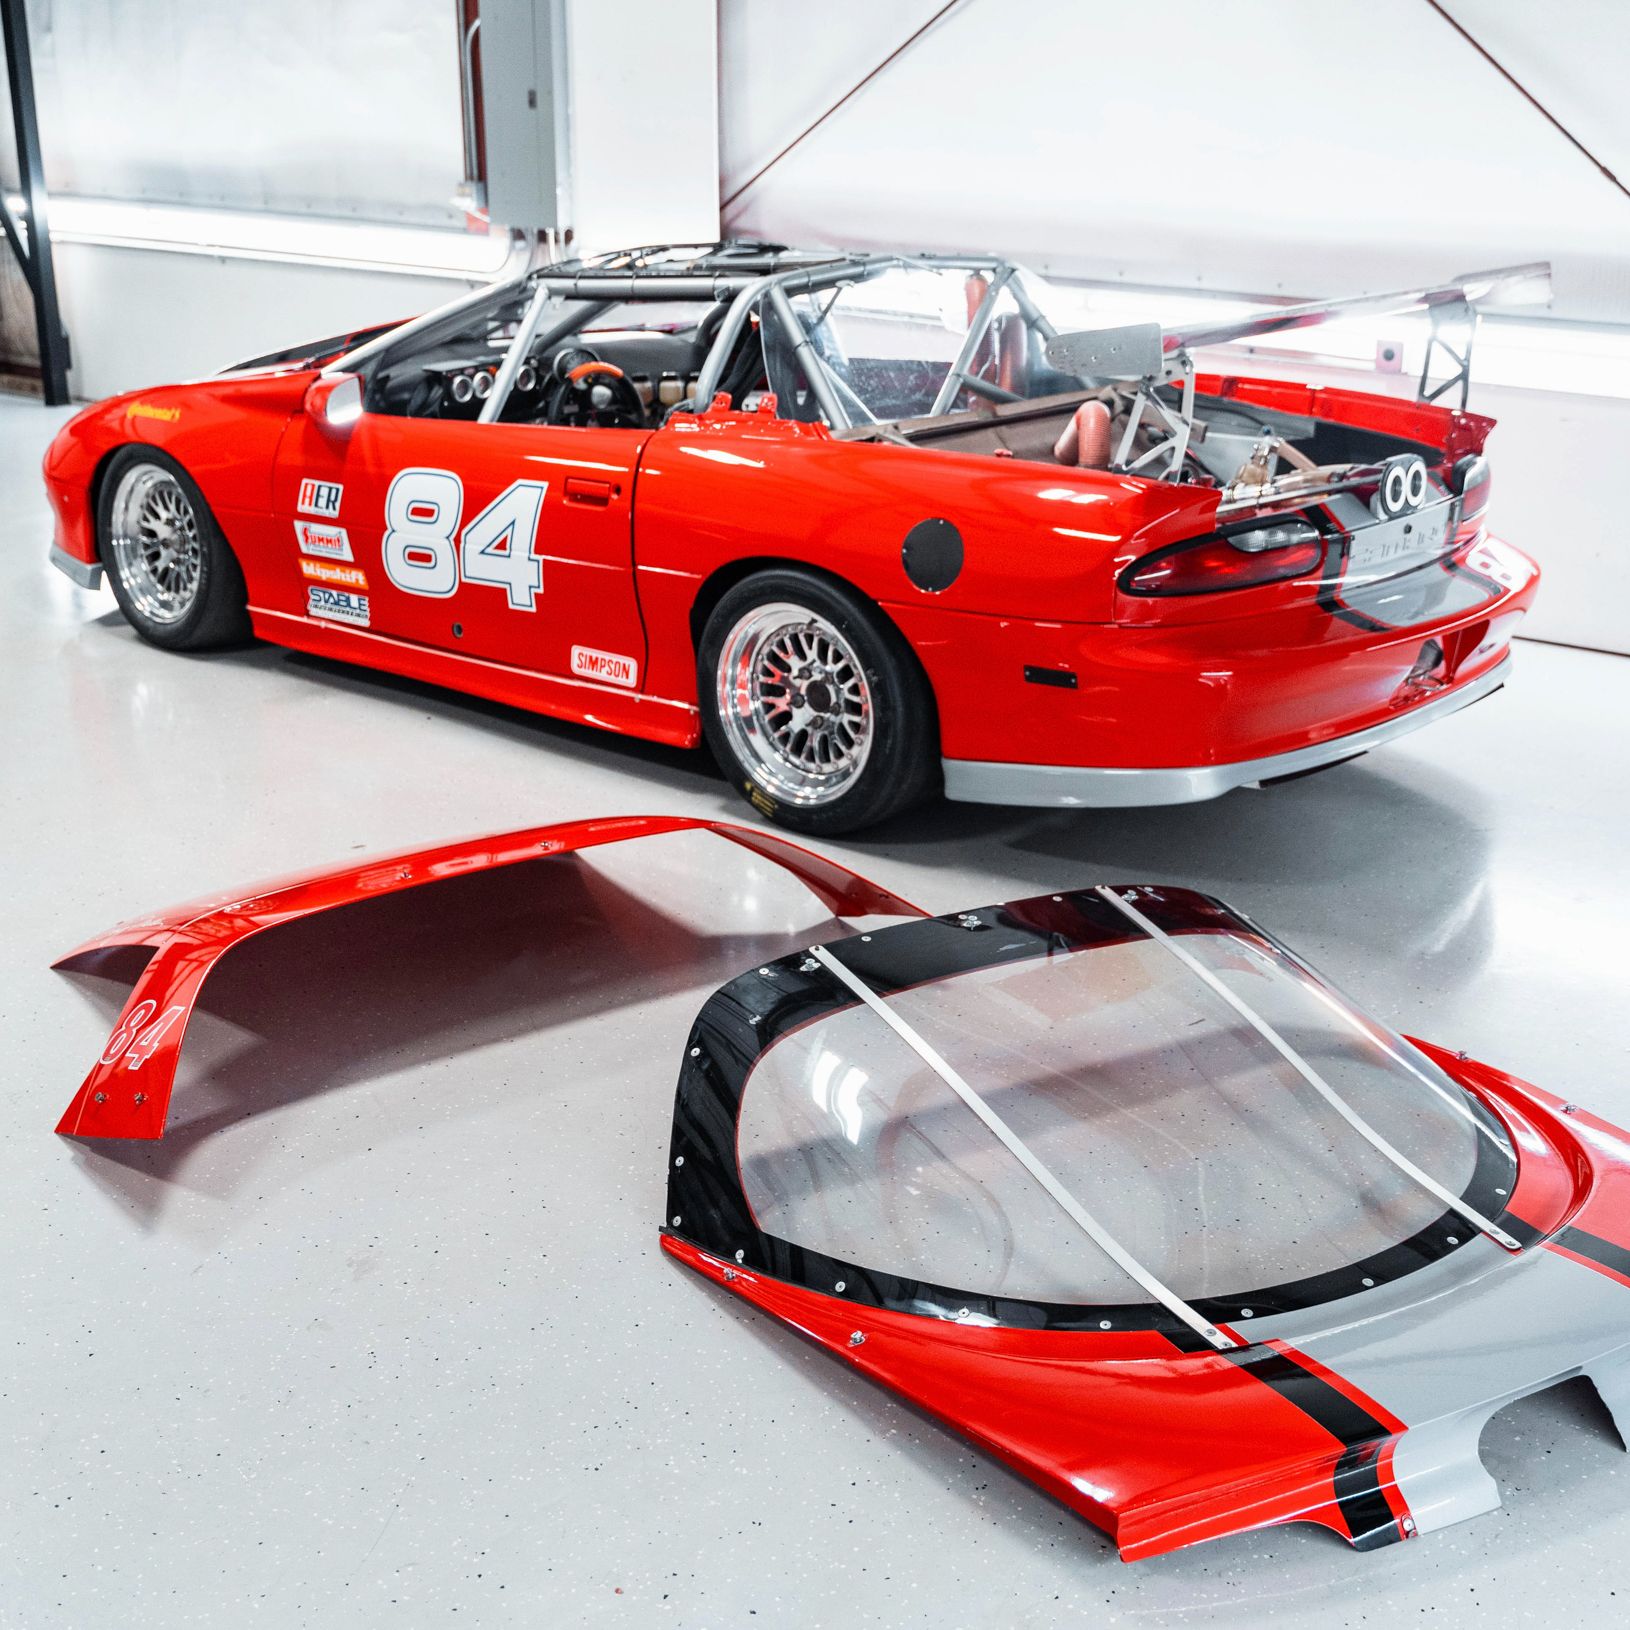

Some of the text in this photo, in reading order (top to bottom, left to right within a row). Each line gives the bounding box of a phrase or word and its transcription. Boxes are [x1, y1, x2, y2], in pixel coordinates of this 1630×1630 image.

[301, 482, 340, 512] AER
[382, 466, 549, 613] 84
[310, 588, 368, 612] STABLE
[577, 651, 631, 681] SIMPSON
[100, 999, 186, 1071] 84
